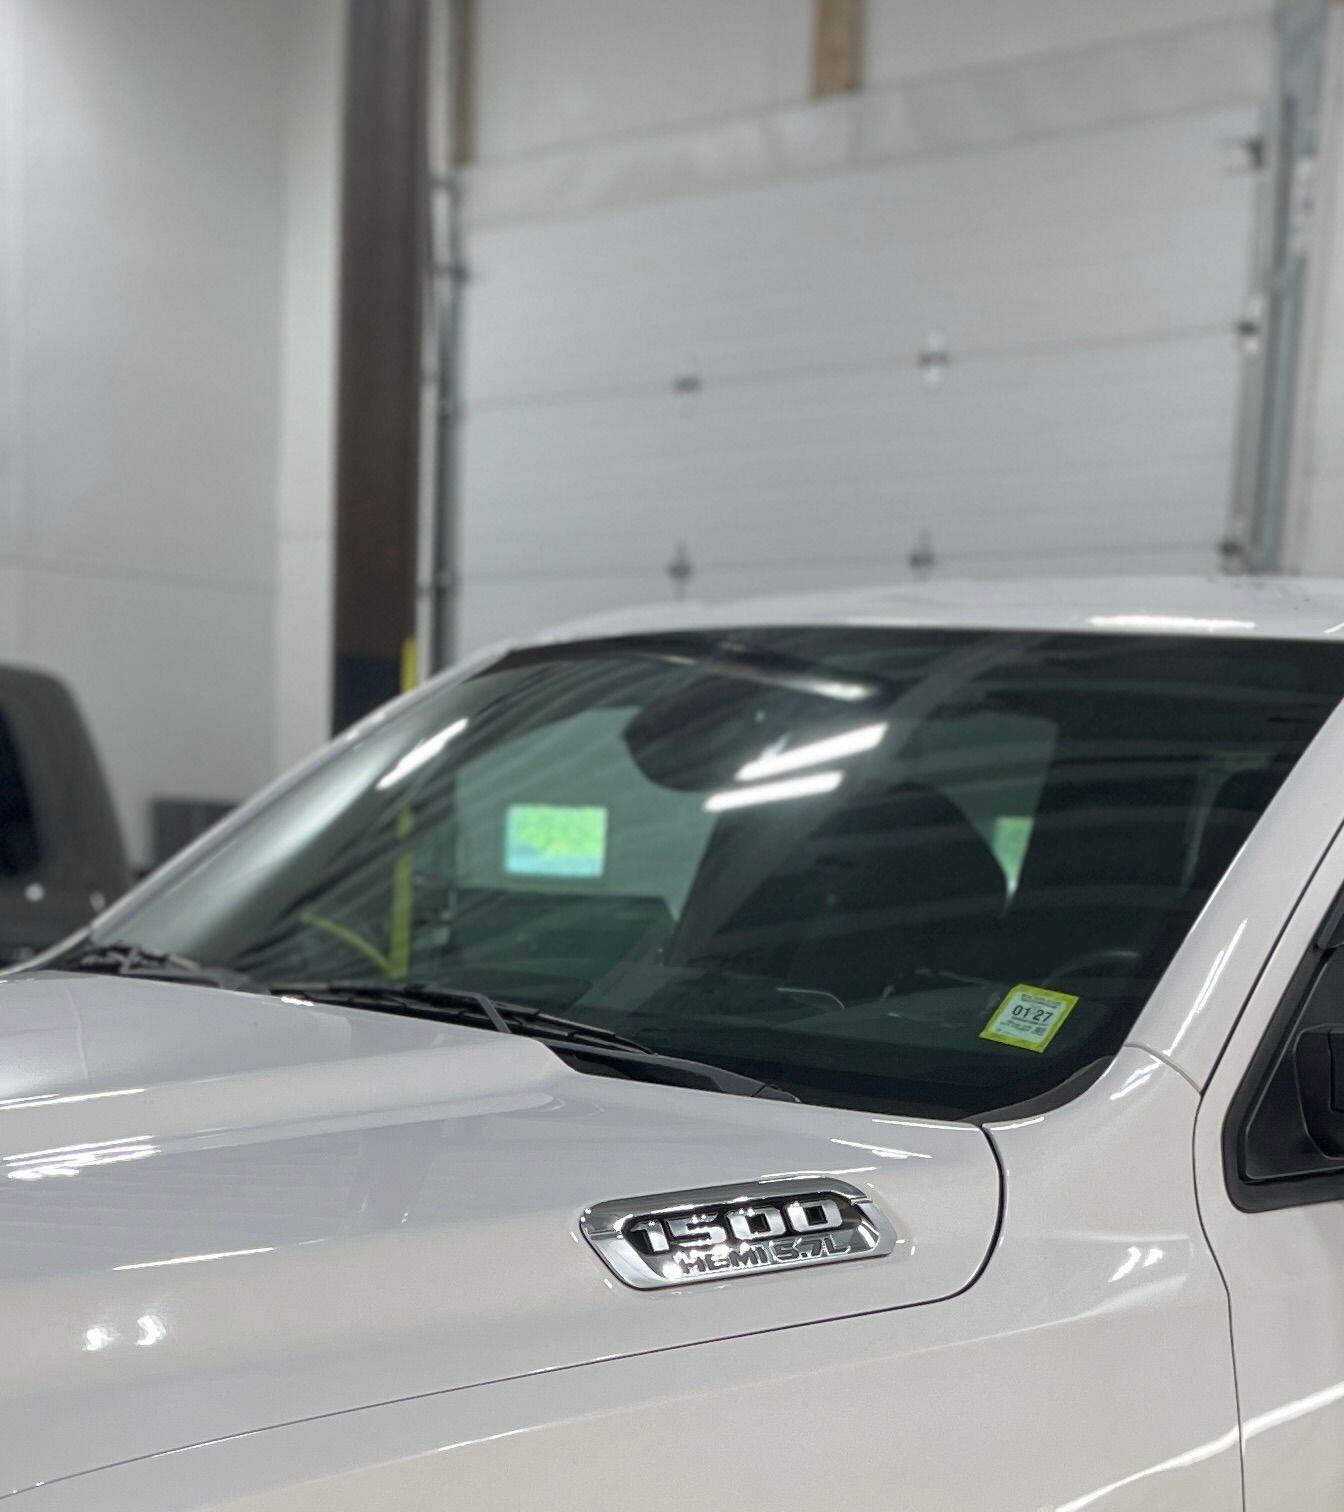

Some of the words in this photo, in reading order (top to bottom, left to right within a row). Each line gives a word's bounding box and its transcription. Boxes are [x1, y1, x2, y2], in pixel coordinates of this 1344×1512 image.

[632, 1200, 844, 1253] 1500
[674, 1244, 768, 1278] HEMI
[771, 1234, 849, 1264] 5.7L
